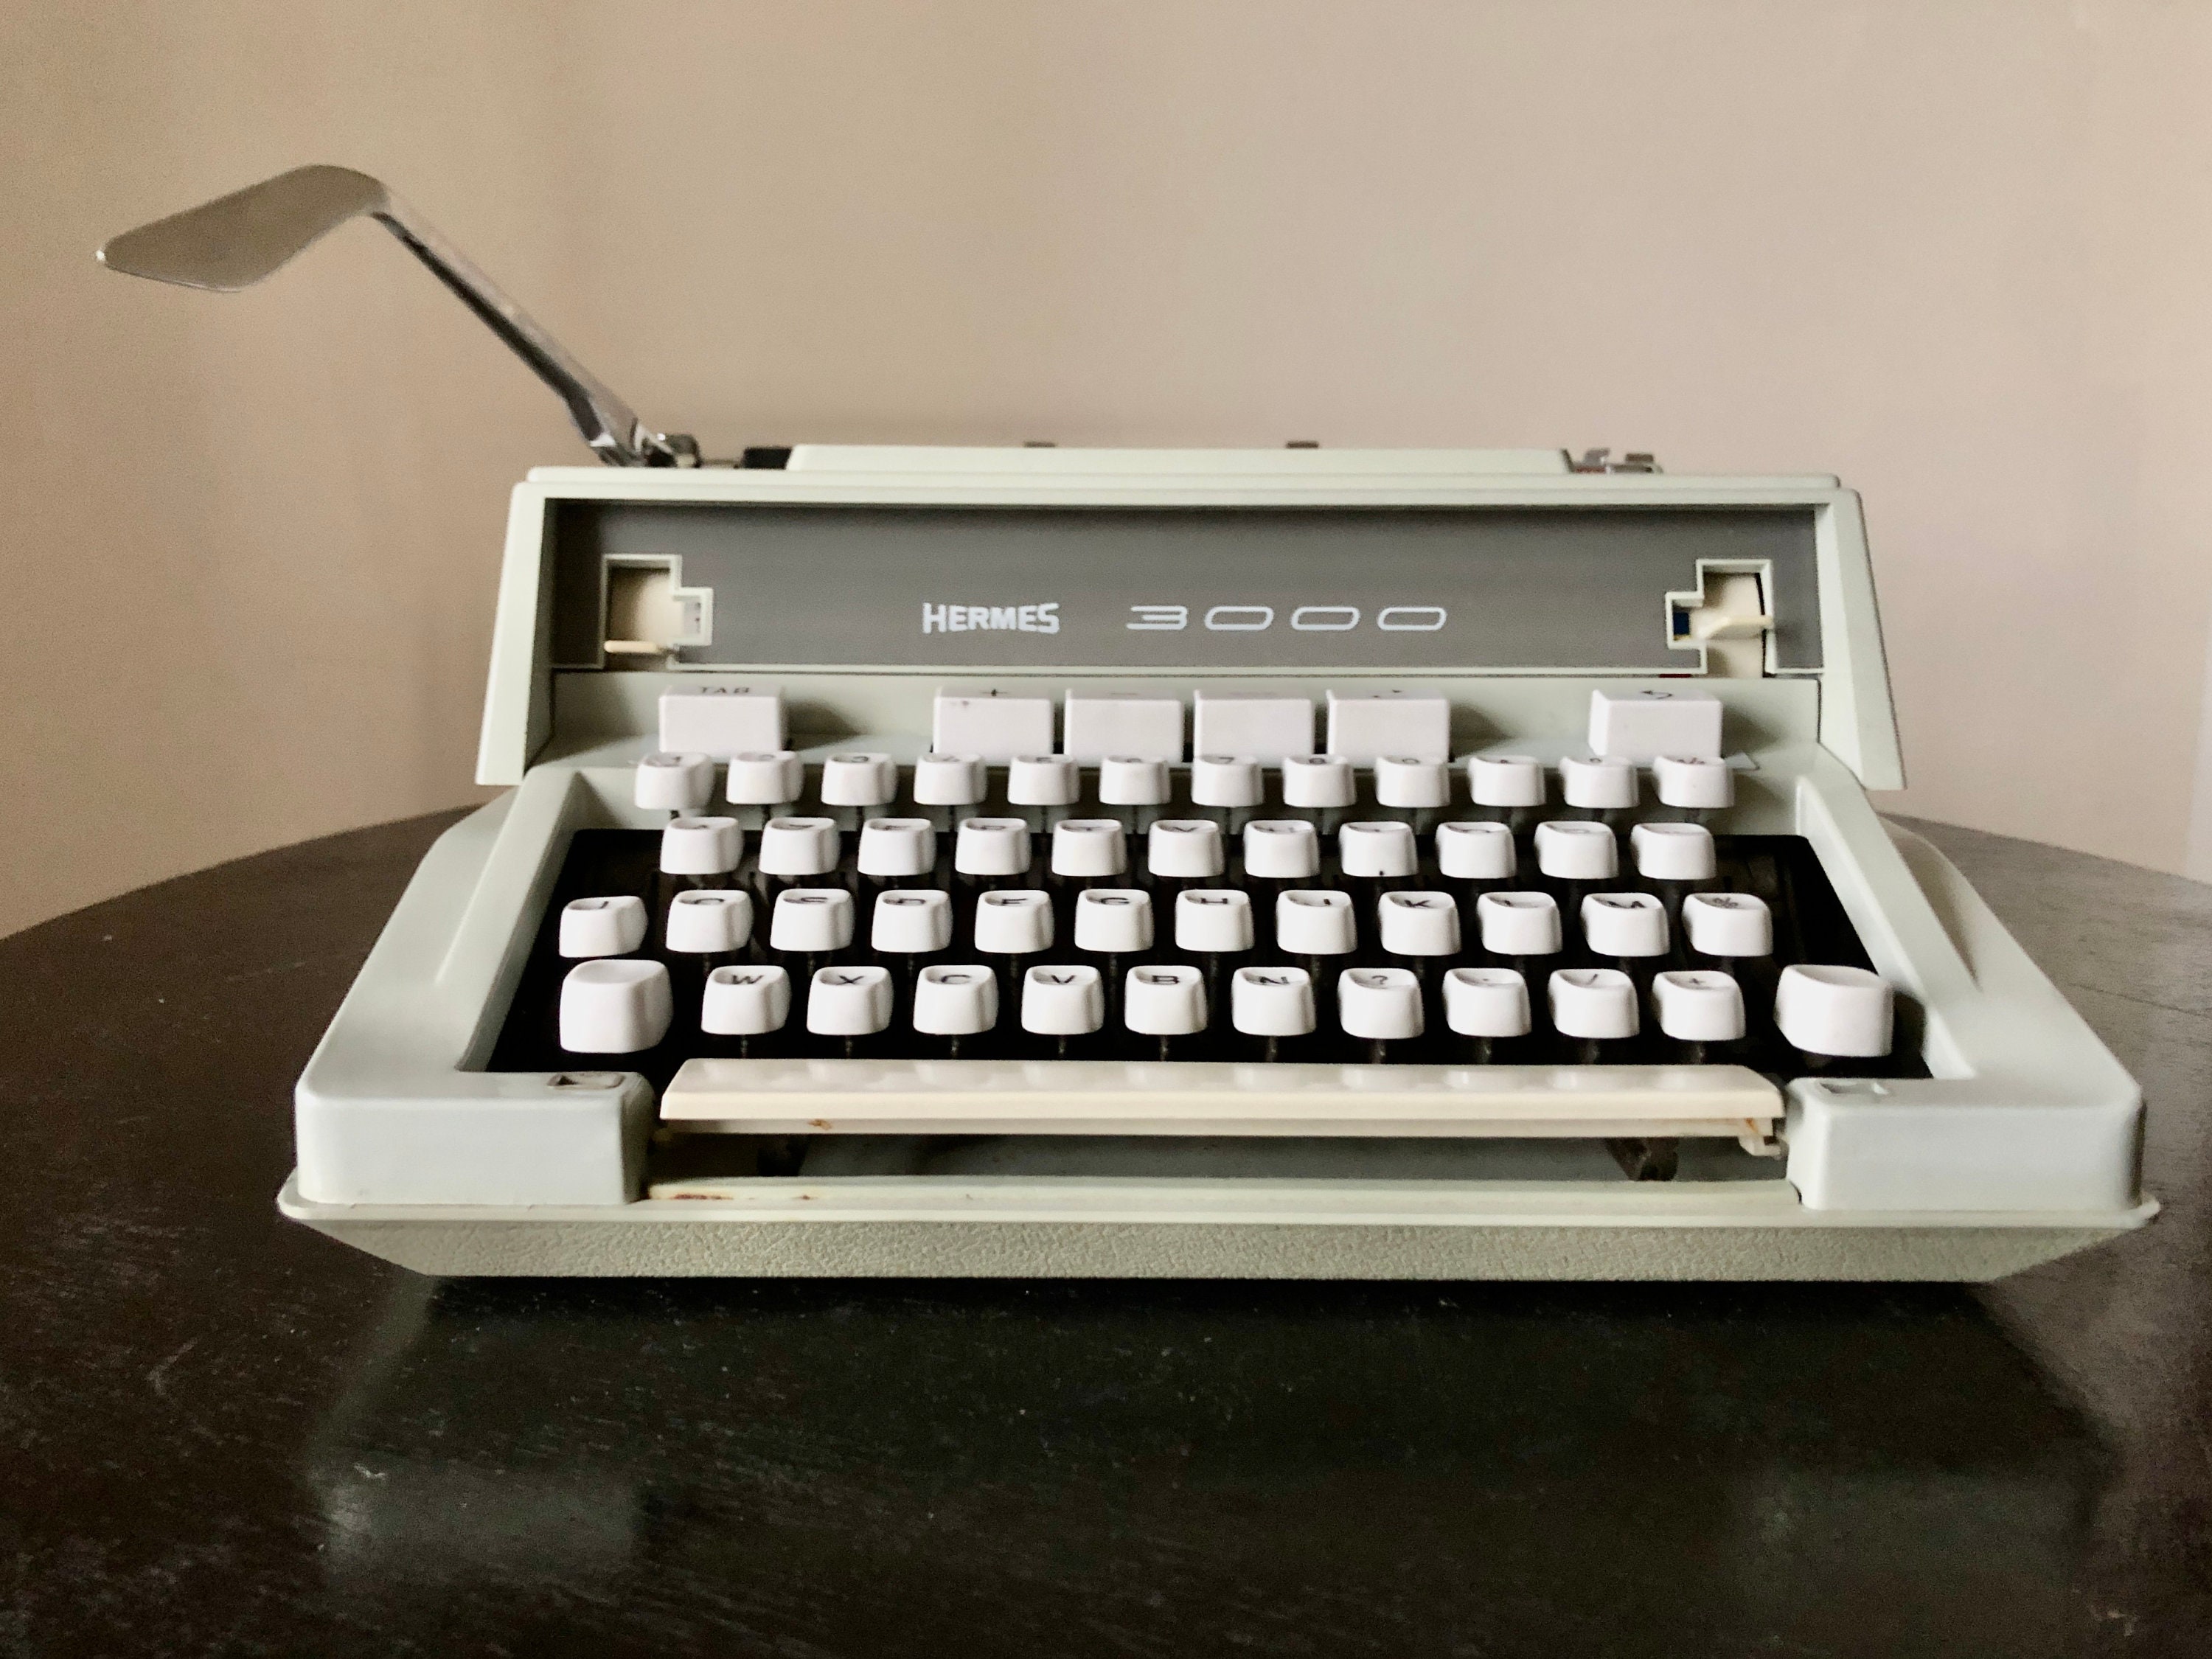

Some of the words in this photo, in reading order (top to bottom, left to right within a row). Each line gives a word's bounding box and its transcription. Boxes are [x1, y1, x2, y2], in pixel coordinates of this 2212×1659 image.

[922, 602, 1060, 634] HERMES
[1125, 605, 1447, 631] 3000
[731, 974, 765, 985] W
[838, 975, 865, 985] X
[1051, 974, 1076, 985] V
